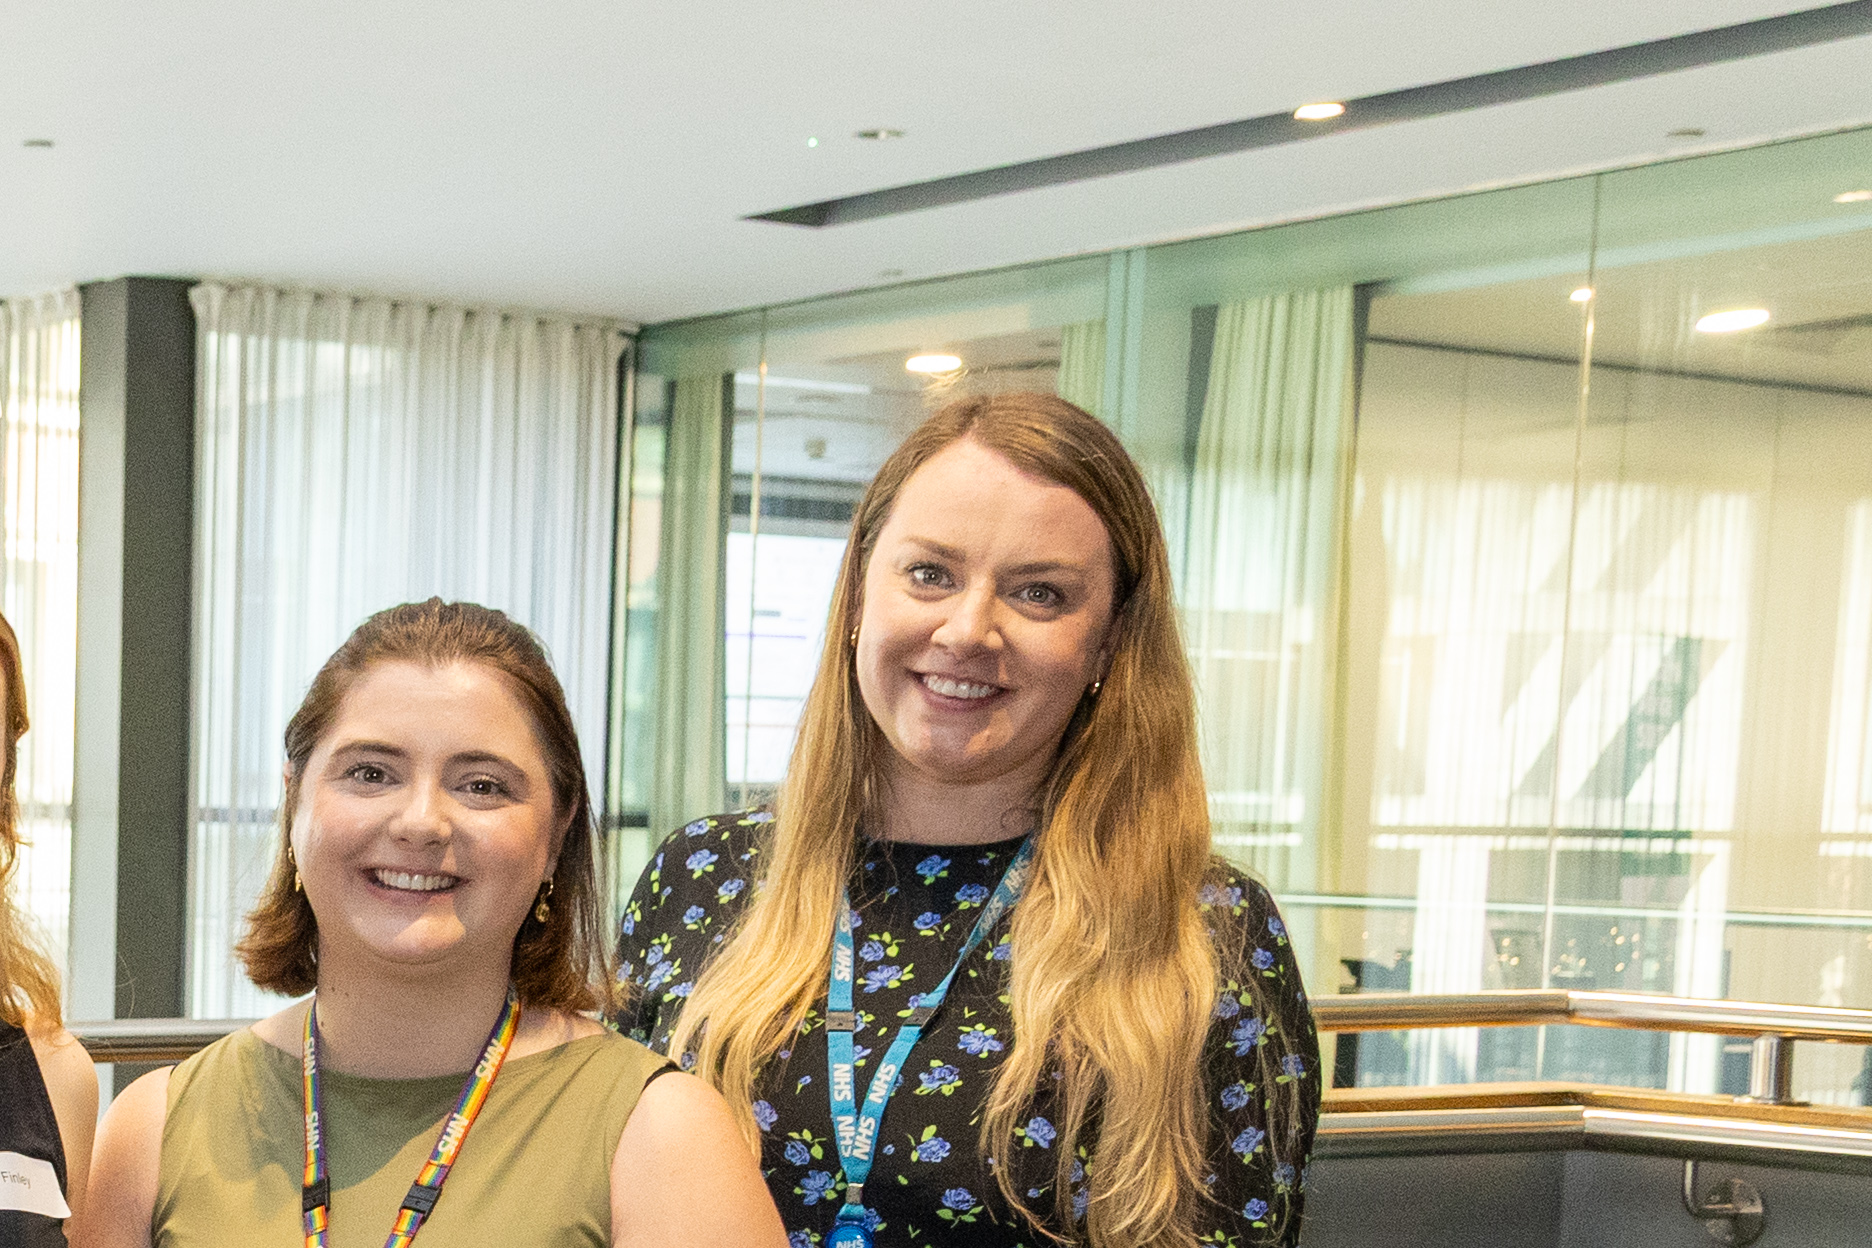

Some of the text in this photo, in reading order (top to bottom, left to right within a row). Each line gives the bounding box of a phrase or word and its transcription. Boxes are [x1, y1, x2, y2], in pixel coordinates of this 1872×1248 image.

[834, 943, 852, 983] NHS
[304, 1037, 317, 1076] NHS
[475, 1038, 506, 1082] NHS
[833, 1063, 852, 1102] NHS
[868, 1063, 896, 1104] NHS
[305, 1111, 320, 1151] NHS
[437, 1113, 469, 1156] NHS
[852, 1116, 876, 1161] NHS
[1, 1171, 31, 1189] Finley
